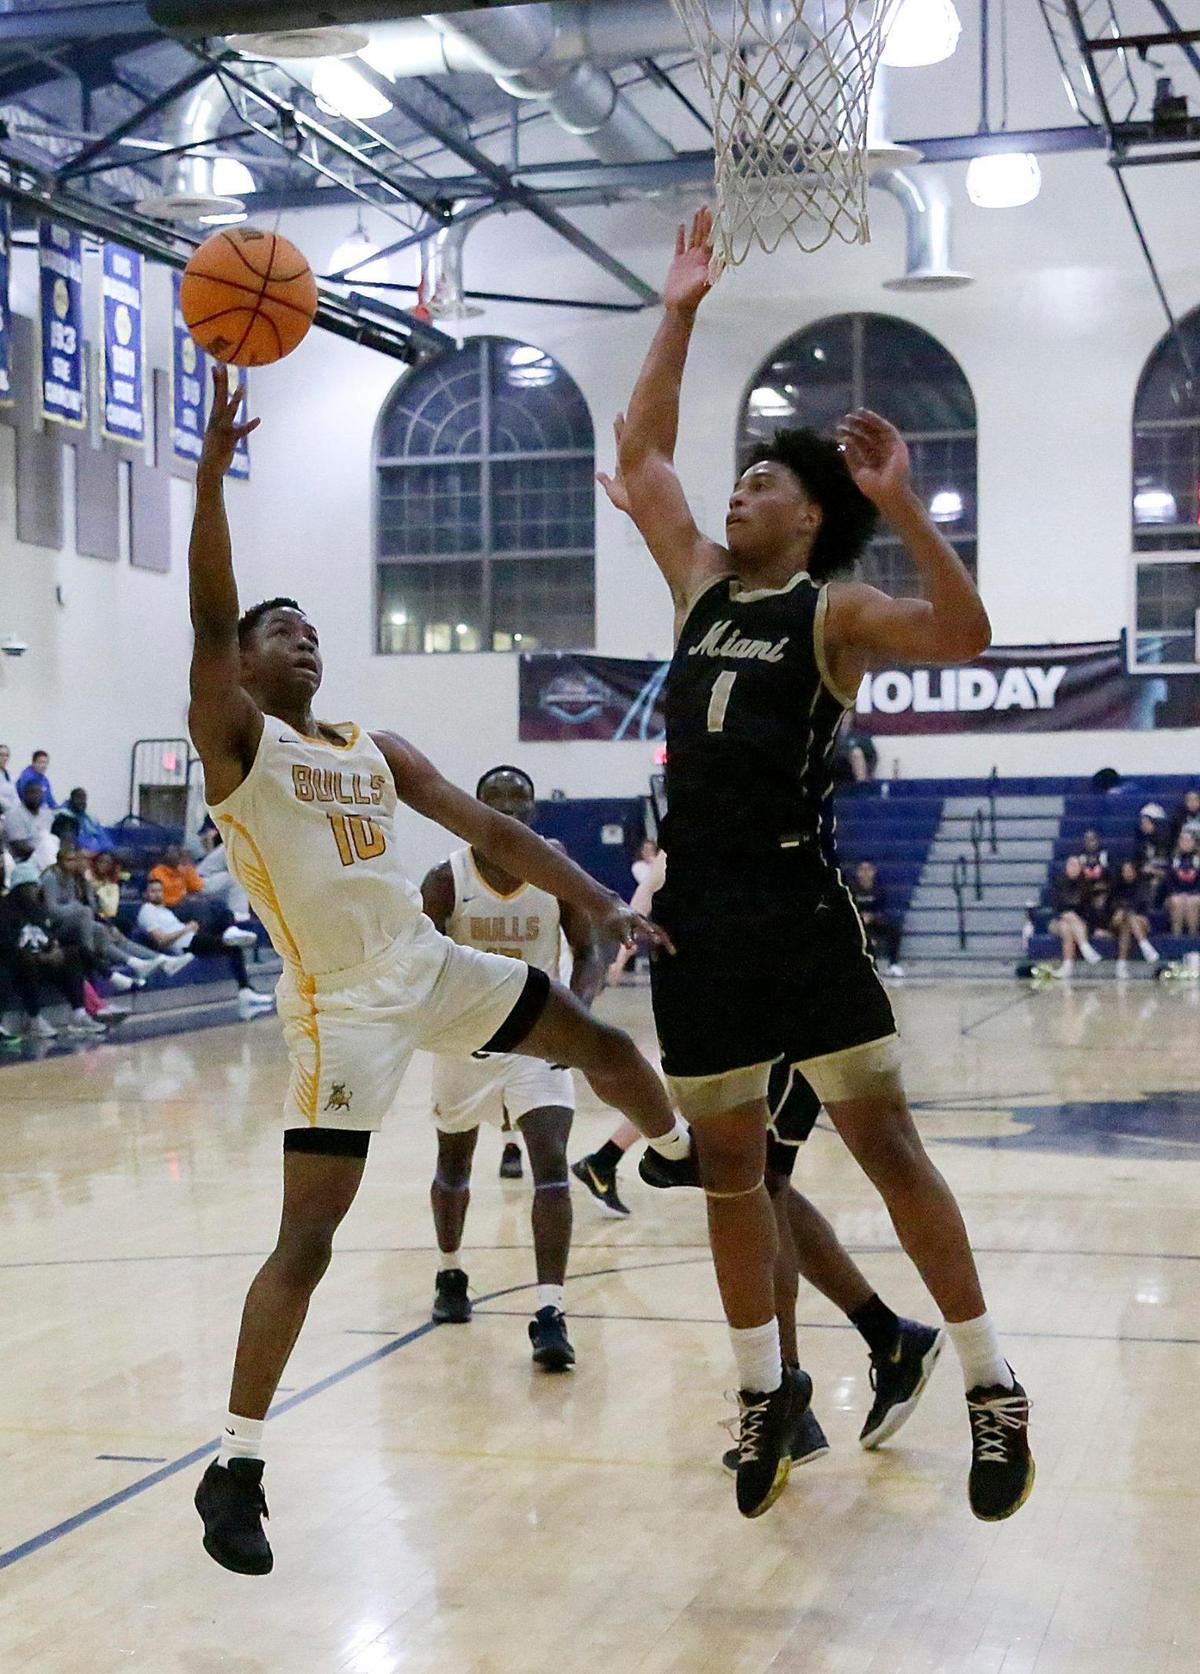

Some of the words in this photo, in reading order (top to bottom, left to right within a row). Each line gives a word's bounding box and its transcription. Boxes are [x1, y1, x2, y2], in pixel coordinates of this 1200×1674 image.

[688, 620, 790, 663] Miami
[707, 670, 737, 733] 1
[292, 764, 386, 805] BULLS
[326, 812, 386, 867] 10
[470, 916, 540, 942] BULLS
